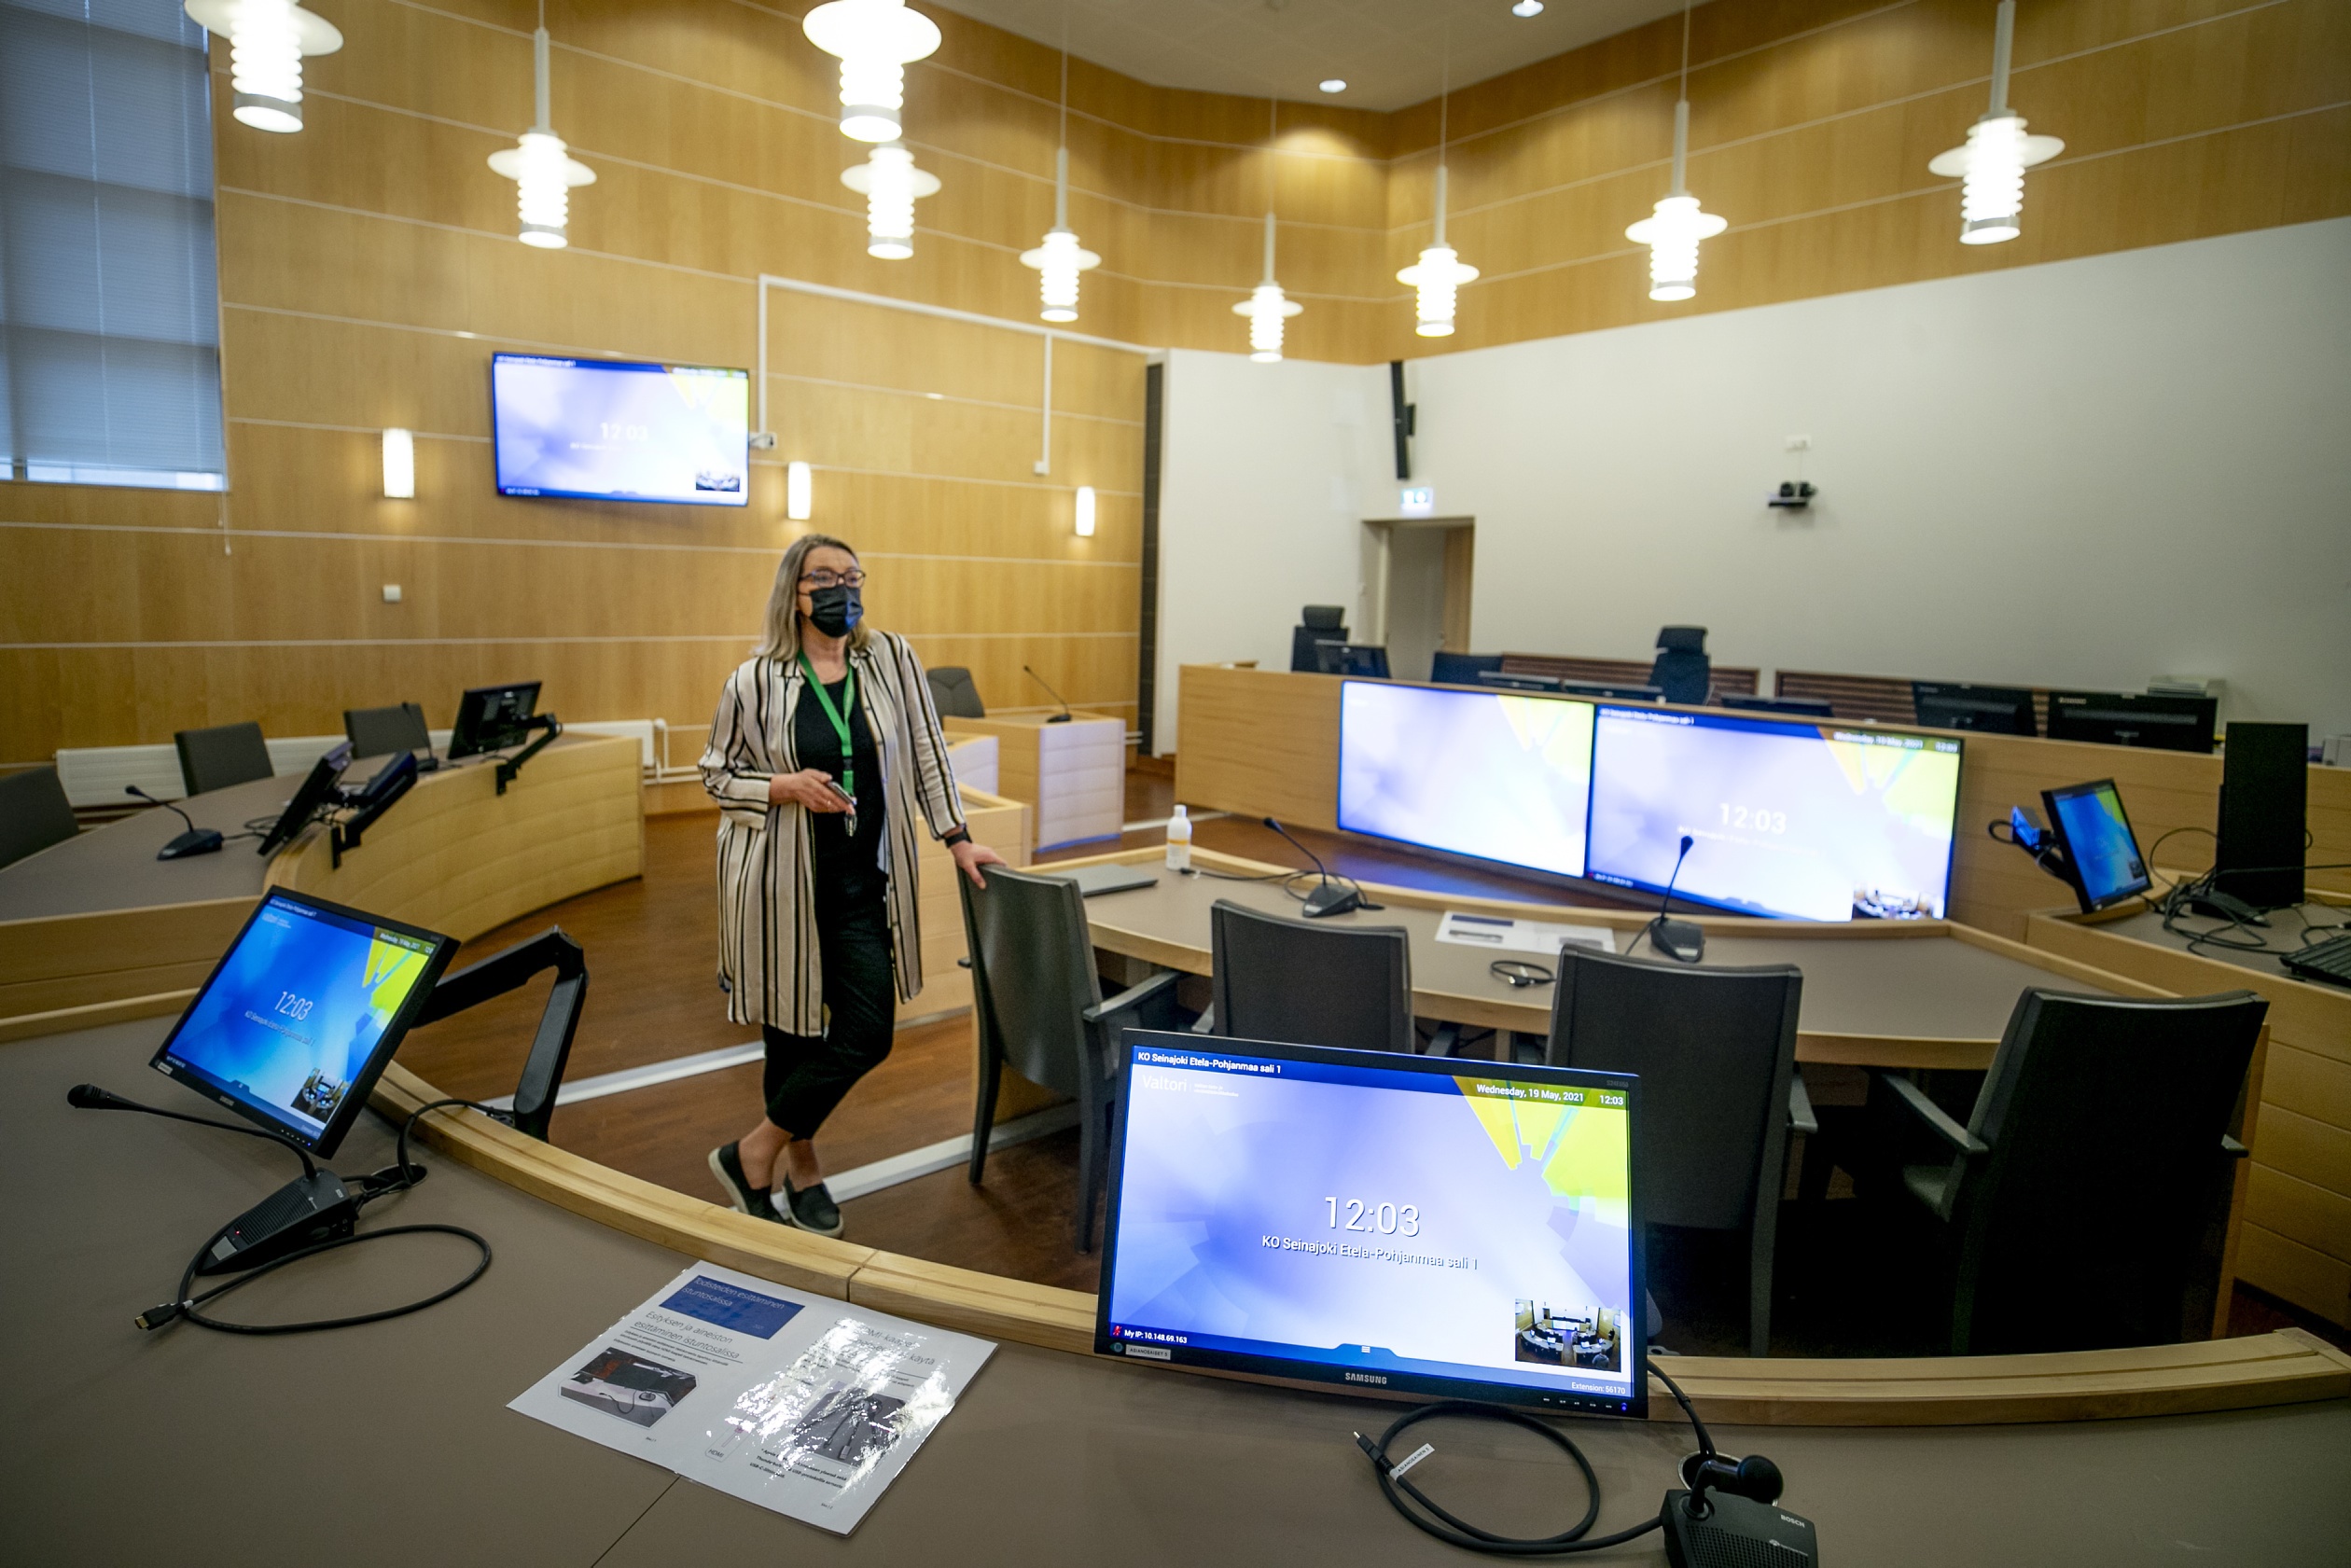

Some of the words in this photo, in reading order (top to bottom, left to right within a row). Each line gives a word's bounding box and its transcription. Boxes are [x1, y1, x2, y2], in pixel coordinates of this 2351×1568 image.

[601, 423, 648, 441] 1203
[1720, 802, 1787, 835] 12:03
[274, 991, 313, 1021] 12:03
[1137, 1052, 1150, 1062] KO
[1151, 1053, 1189, 1065] Seinajoki
[1189, 1057, 1259, 1072] Etela-Pohjanmaa
[1259, 1063, 1274, 1074] sali
[1276, 1065, 1281, 1074] 1
[1142, 1075, 1188, 1092] Valtori
[1476, 1084, 1527, 1098] Wednesday,
[1529, 1089, 1539, 1098] 19
[1541, 1089, 1562, 1102] May,
[1563, 1091, 1584, 1102] 2021
[1599, 1094, 1624, 1105] 12:03
[1325, 1196, 1420, 1237] 12:03
[1261, 1235, 1281, 1249] KO
[1283, 1238, 1338, 1256] Seinajoki
[1340, 1243, 1444, 1267] Etela-Pohjanmaa
[1447, 1256, 1468, 1270] sali
[681, 1286, 733, 1307] istuntosalissa
[693, 1277, 737, 1297] Todisteiden
[646, 1311, 685, 1329] Esityksen
[683, 1322, 694, 1332] ja
[693, 1325, 733, 1344] aineiston
[1124, 1329, 1134, 1339] My
[634, 1321, 683, 1341] esittäminen
[683, 1335, 740, 1359] istuntosalissa
[1344, 1372, 1387, 1385] SAMSUNG
[1571, 1381, 1605, 1392] Extension:
[1606, 1385, 1626, 1395] 56170
[707, 1449, 725, 1458] HDMI
